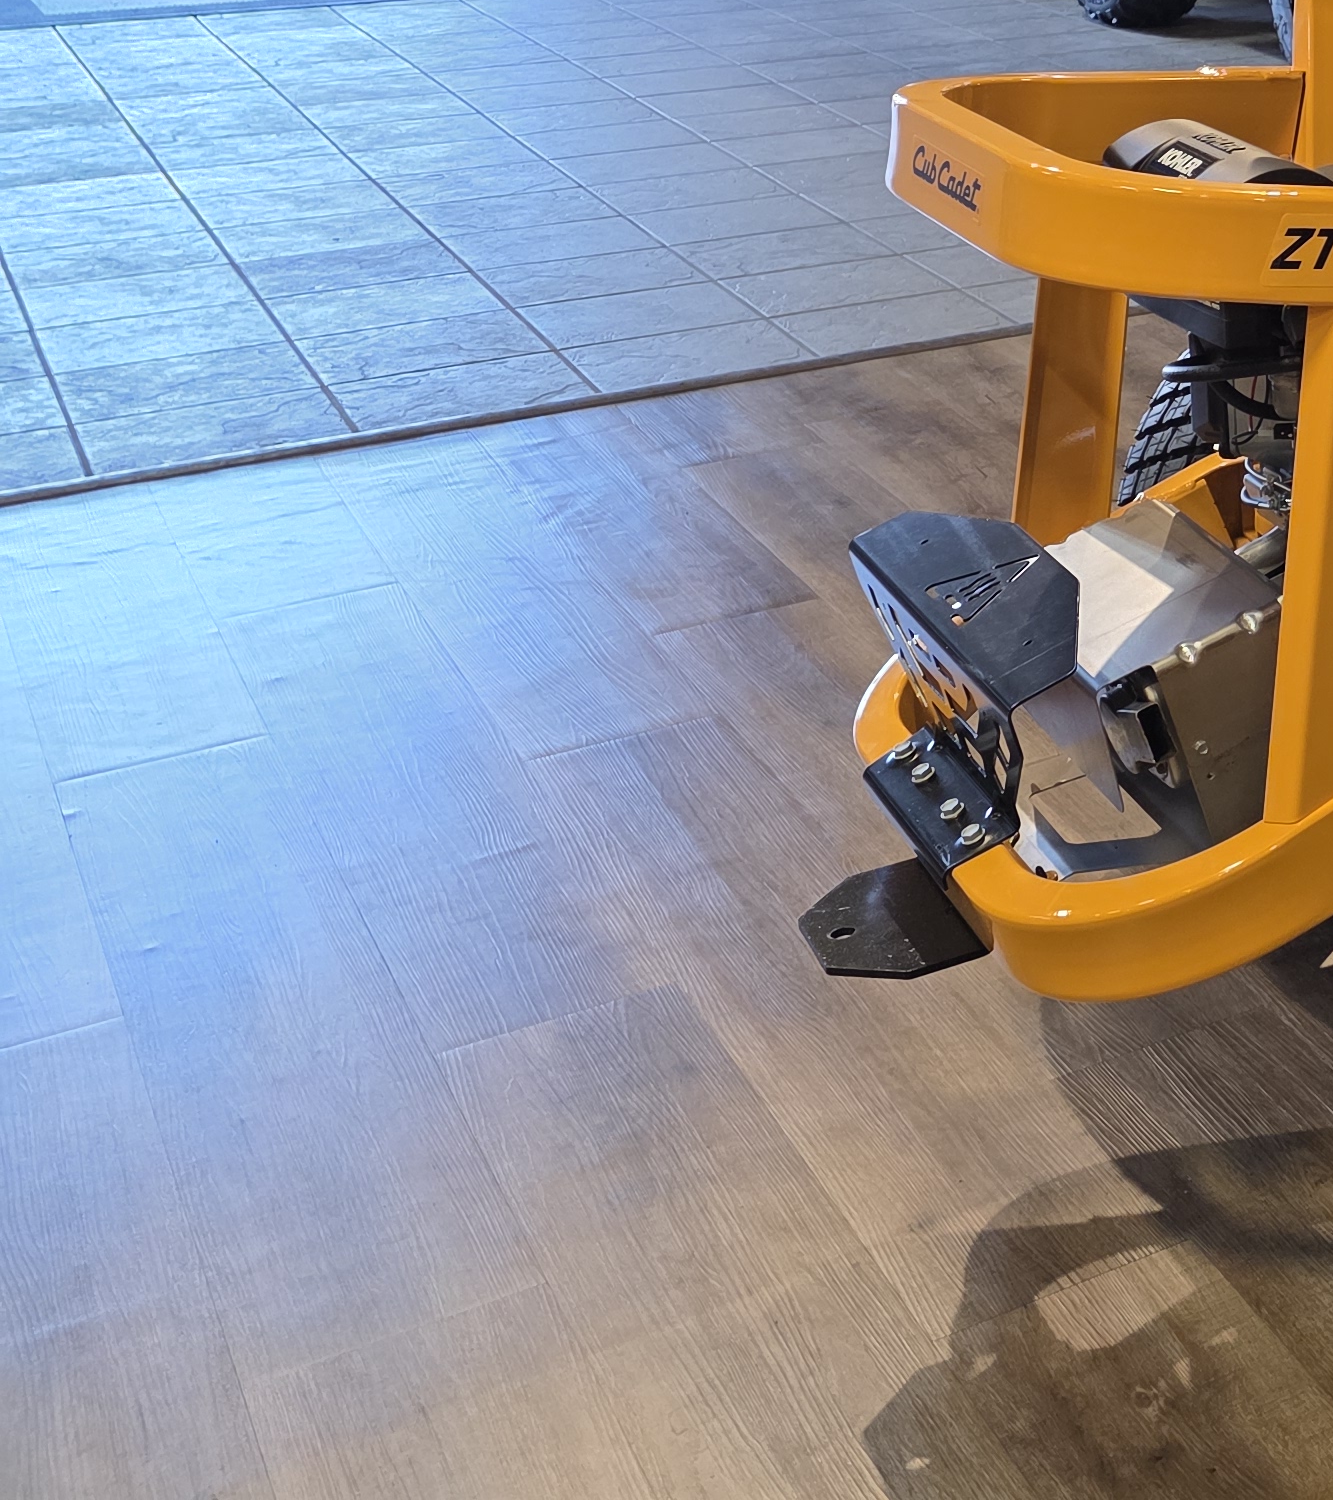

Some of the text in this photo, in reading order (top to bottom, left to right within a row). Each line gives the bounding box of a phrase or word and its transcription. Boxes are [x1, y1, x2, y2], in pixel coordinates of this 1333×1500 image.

[912, 145, 982, 212] Cub Cadet
[1157, 147, 1203, 178] KOHLER
